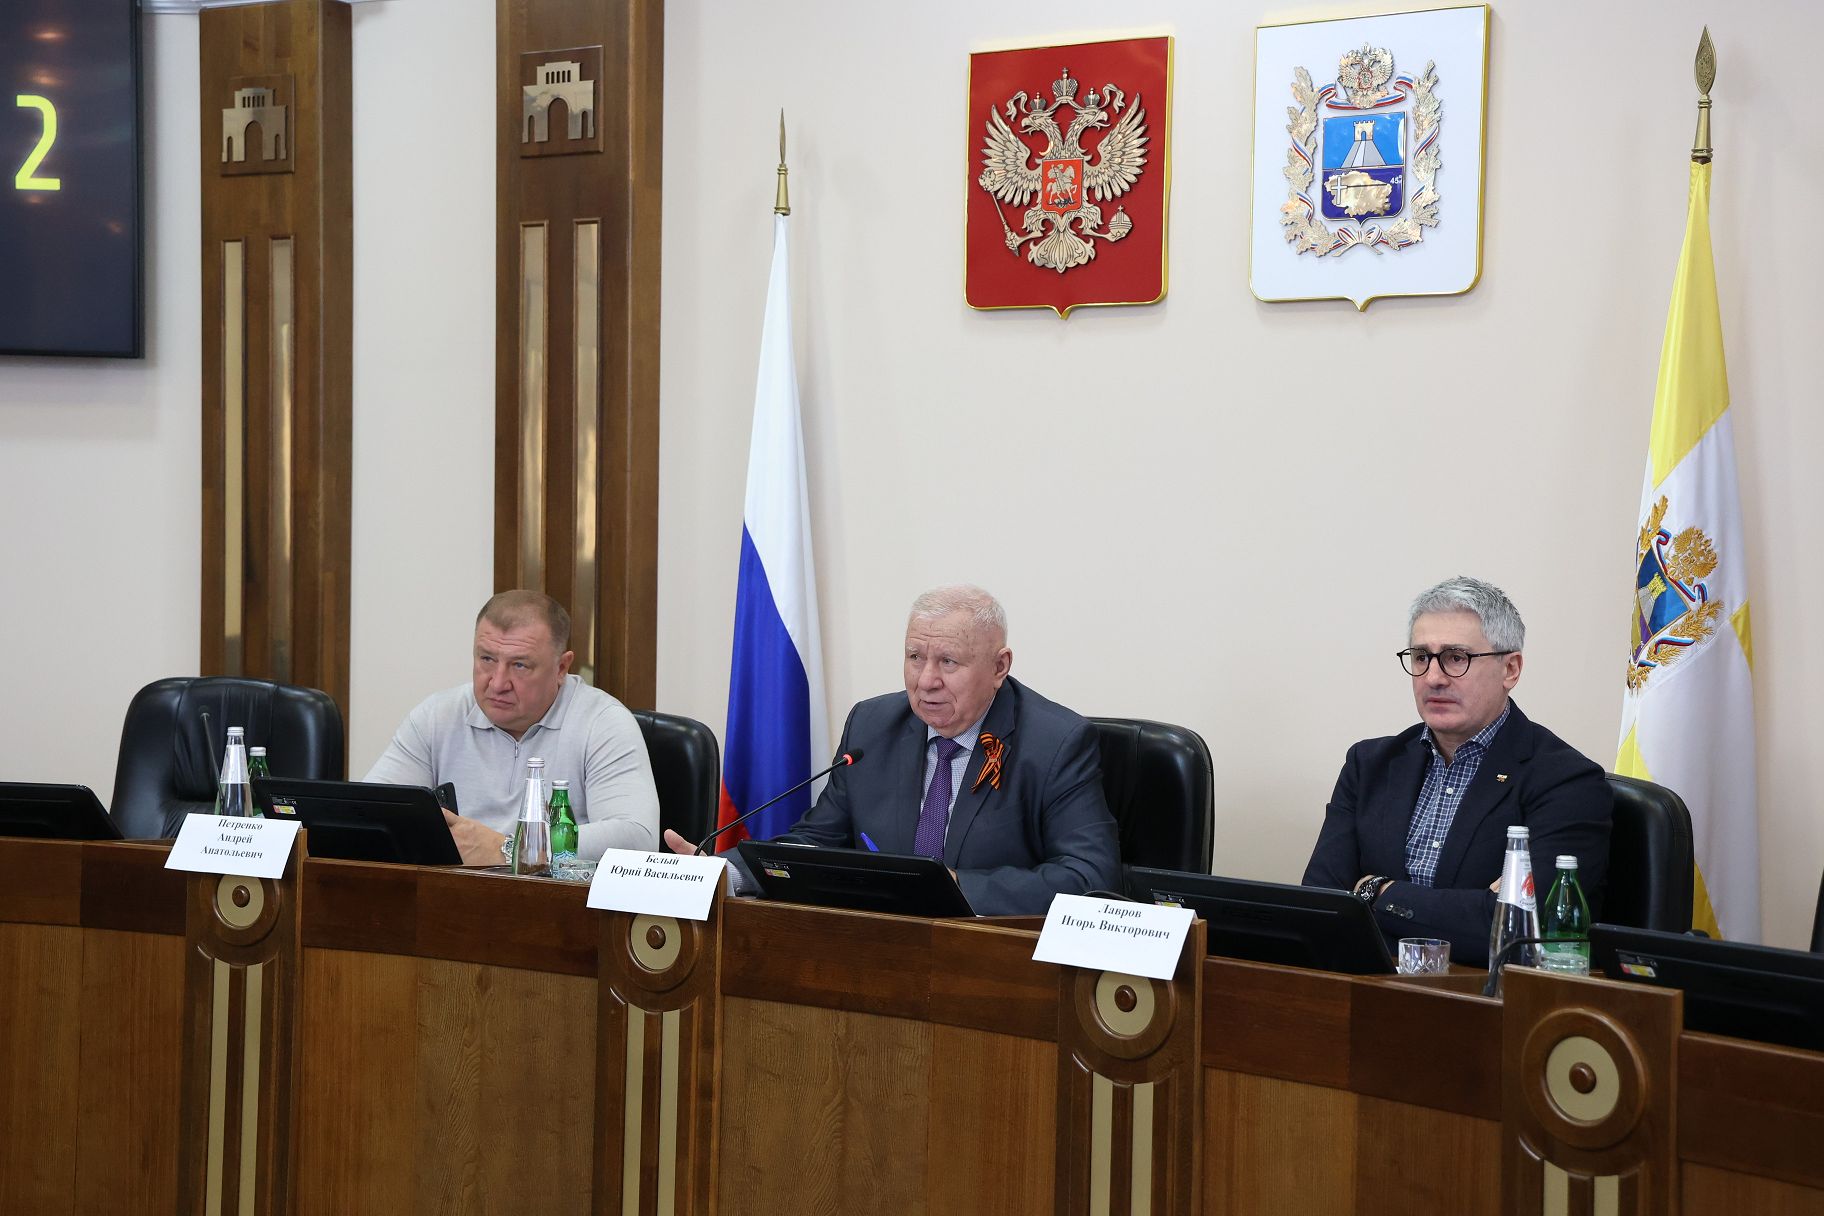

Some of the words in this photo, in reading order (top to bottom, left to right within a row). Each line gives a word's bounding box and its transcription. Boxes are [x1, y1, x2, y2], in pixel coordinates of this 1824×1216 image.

[15, 94, 61, 191] 2
[218, 819, 263, 830] Петренко
[219, 833, 253, 844] Андрей
[201, 846, 263, 858] Анатольевич
[645, 855, 679, 865] Белый
[610, 865, 641, 877] Юрий
[643, 868, 704, 882] Васильевич
[1098, 904, 1142, 918] Лавров
[1061, 915, 1096, 931] Игорь
[1099, 920, 1170, 939] Викторович
